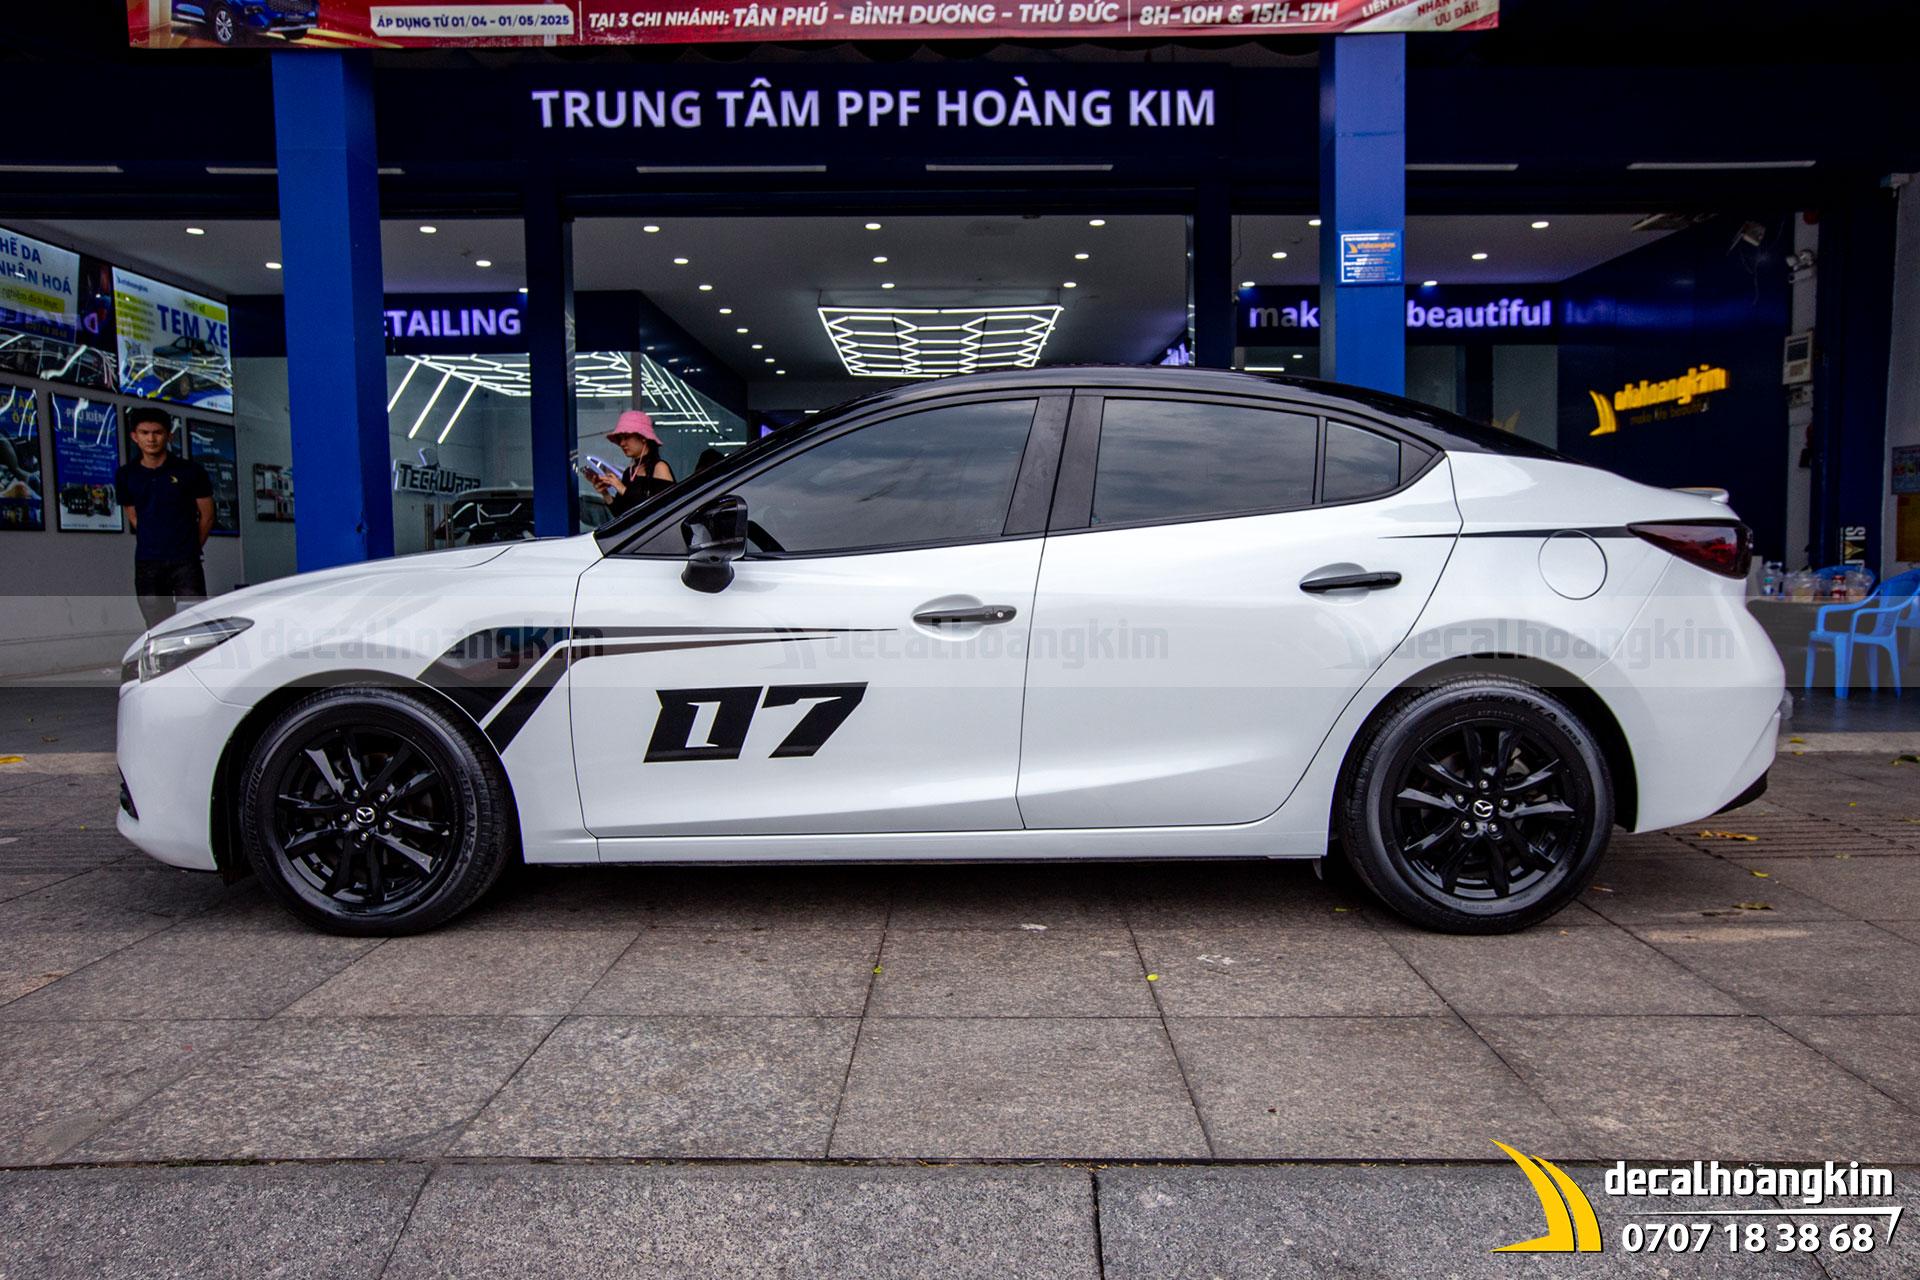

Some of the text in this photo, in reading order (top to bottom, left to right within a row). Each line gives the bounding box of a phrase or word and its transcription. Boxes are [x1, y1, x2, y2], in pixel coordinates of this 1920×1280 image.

[377, 14, 393, 28] ÁP
[396, 16, 431, 31] DỤNG
[433, 13, 449, 28] TỪ
[451, 15, 487, 28] 01/04
[498, 14, 570, 27] 01/05/2025
[589, 12, 615, 31] TẠI
[618, 12, 629, 27] 3
[631, 12, 662, 27] CHI
[664, 8, 730, 26] NHÁNH:
[733, 4, 777, 27] TÂN
[781, 2, 829, 25] PHÚ
[850, 2, 904, 24] BÌNH
[909, 3, 996, 24] DƯƠNG
[1019, 0, 1063, 23] THỦ
[1068, 1, 1119, 22] ĐỨC
[1139, 2, 1339, 25] 8H-10H & 15H-17H
[531, 76, 1215, 128] TRUNG TÂM PPF HOÀNG KIM
[0, 236, 42, 264] HẾ DA
[42, 273, 73, 295] HOÁ
[157, 304, 200, 339] TEM
[206, 319, 228, 348] XE
[384, 308, 522, 338] TAILING
[1250, 300, 1320, 328] mak
[1407, 298, 1551, 328] beautiful
[643, 681, 869, 763] 07
